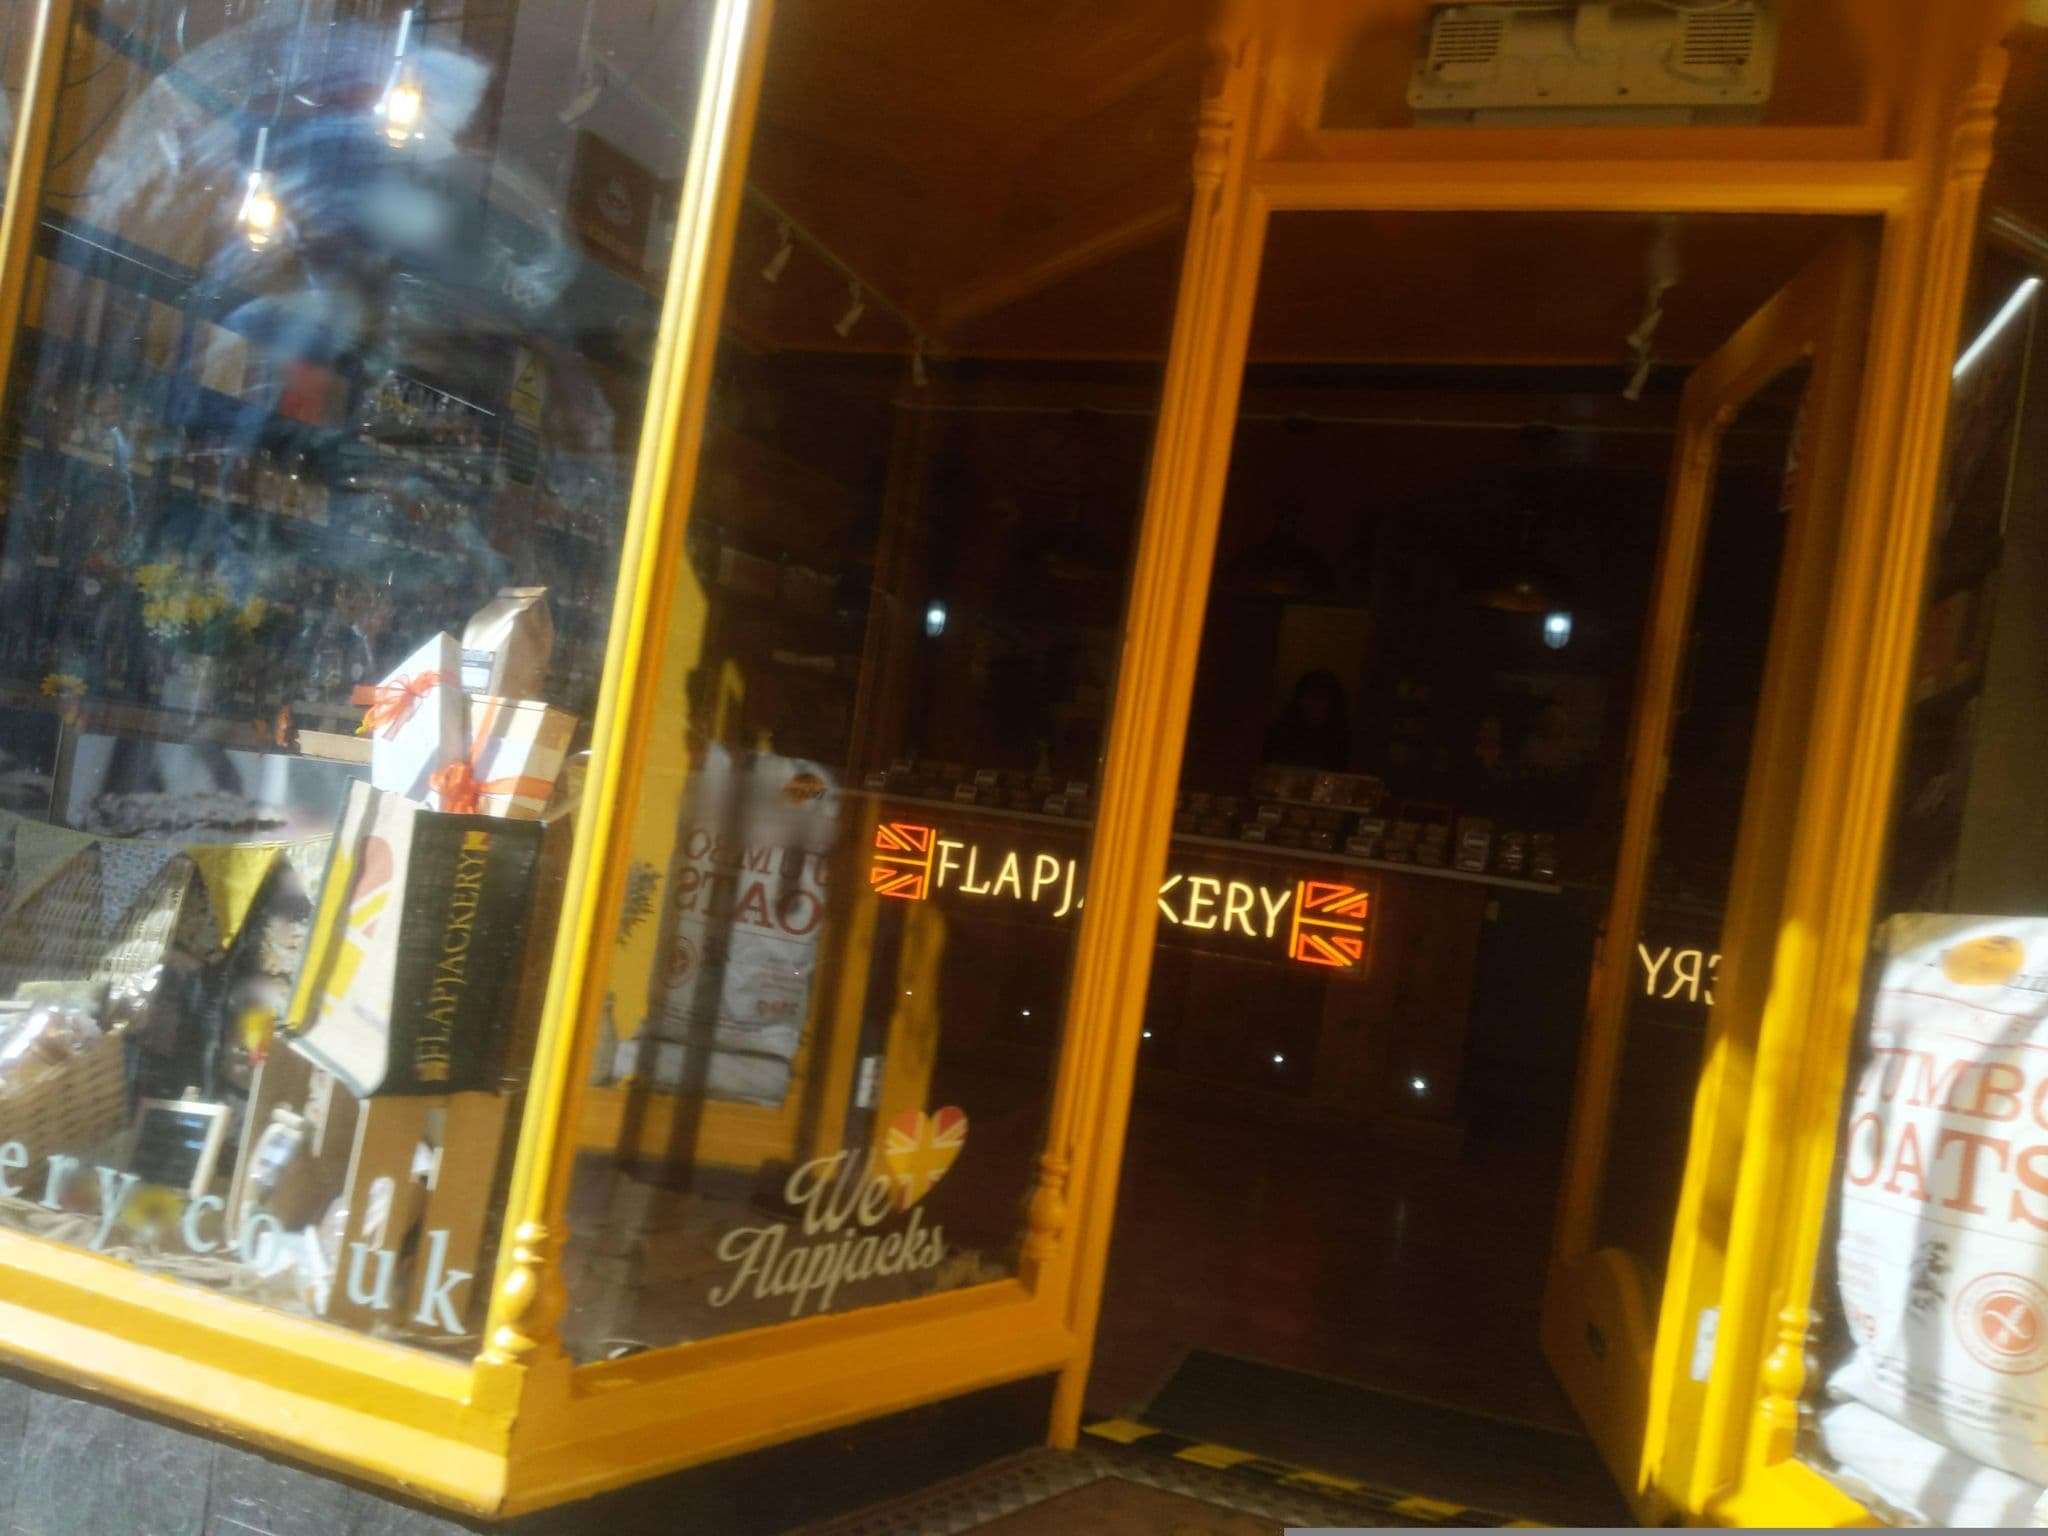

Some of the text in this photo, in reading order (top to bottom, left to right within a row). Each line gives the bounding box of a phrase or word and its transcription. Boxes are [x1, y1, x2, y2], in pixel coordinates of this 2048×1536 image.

[935, 840, 1292, 938] FLAPJKERY
[783, 1147, 893, 1236] We
[1847, 1111, 2048, 1234] OATS
[707, 1206, 945, 1317] Flapjacks
